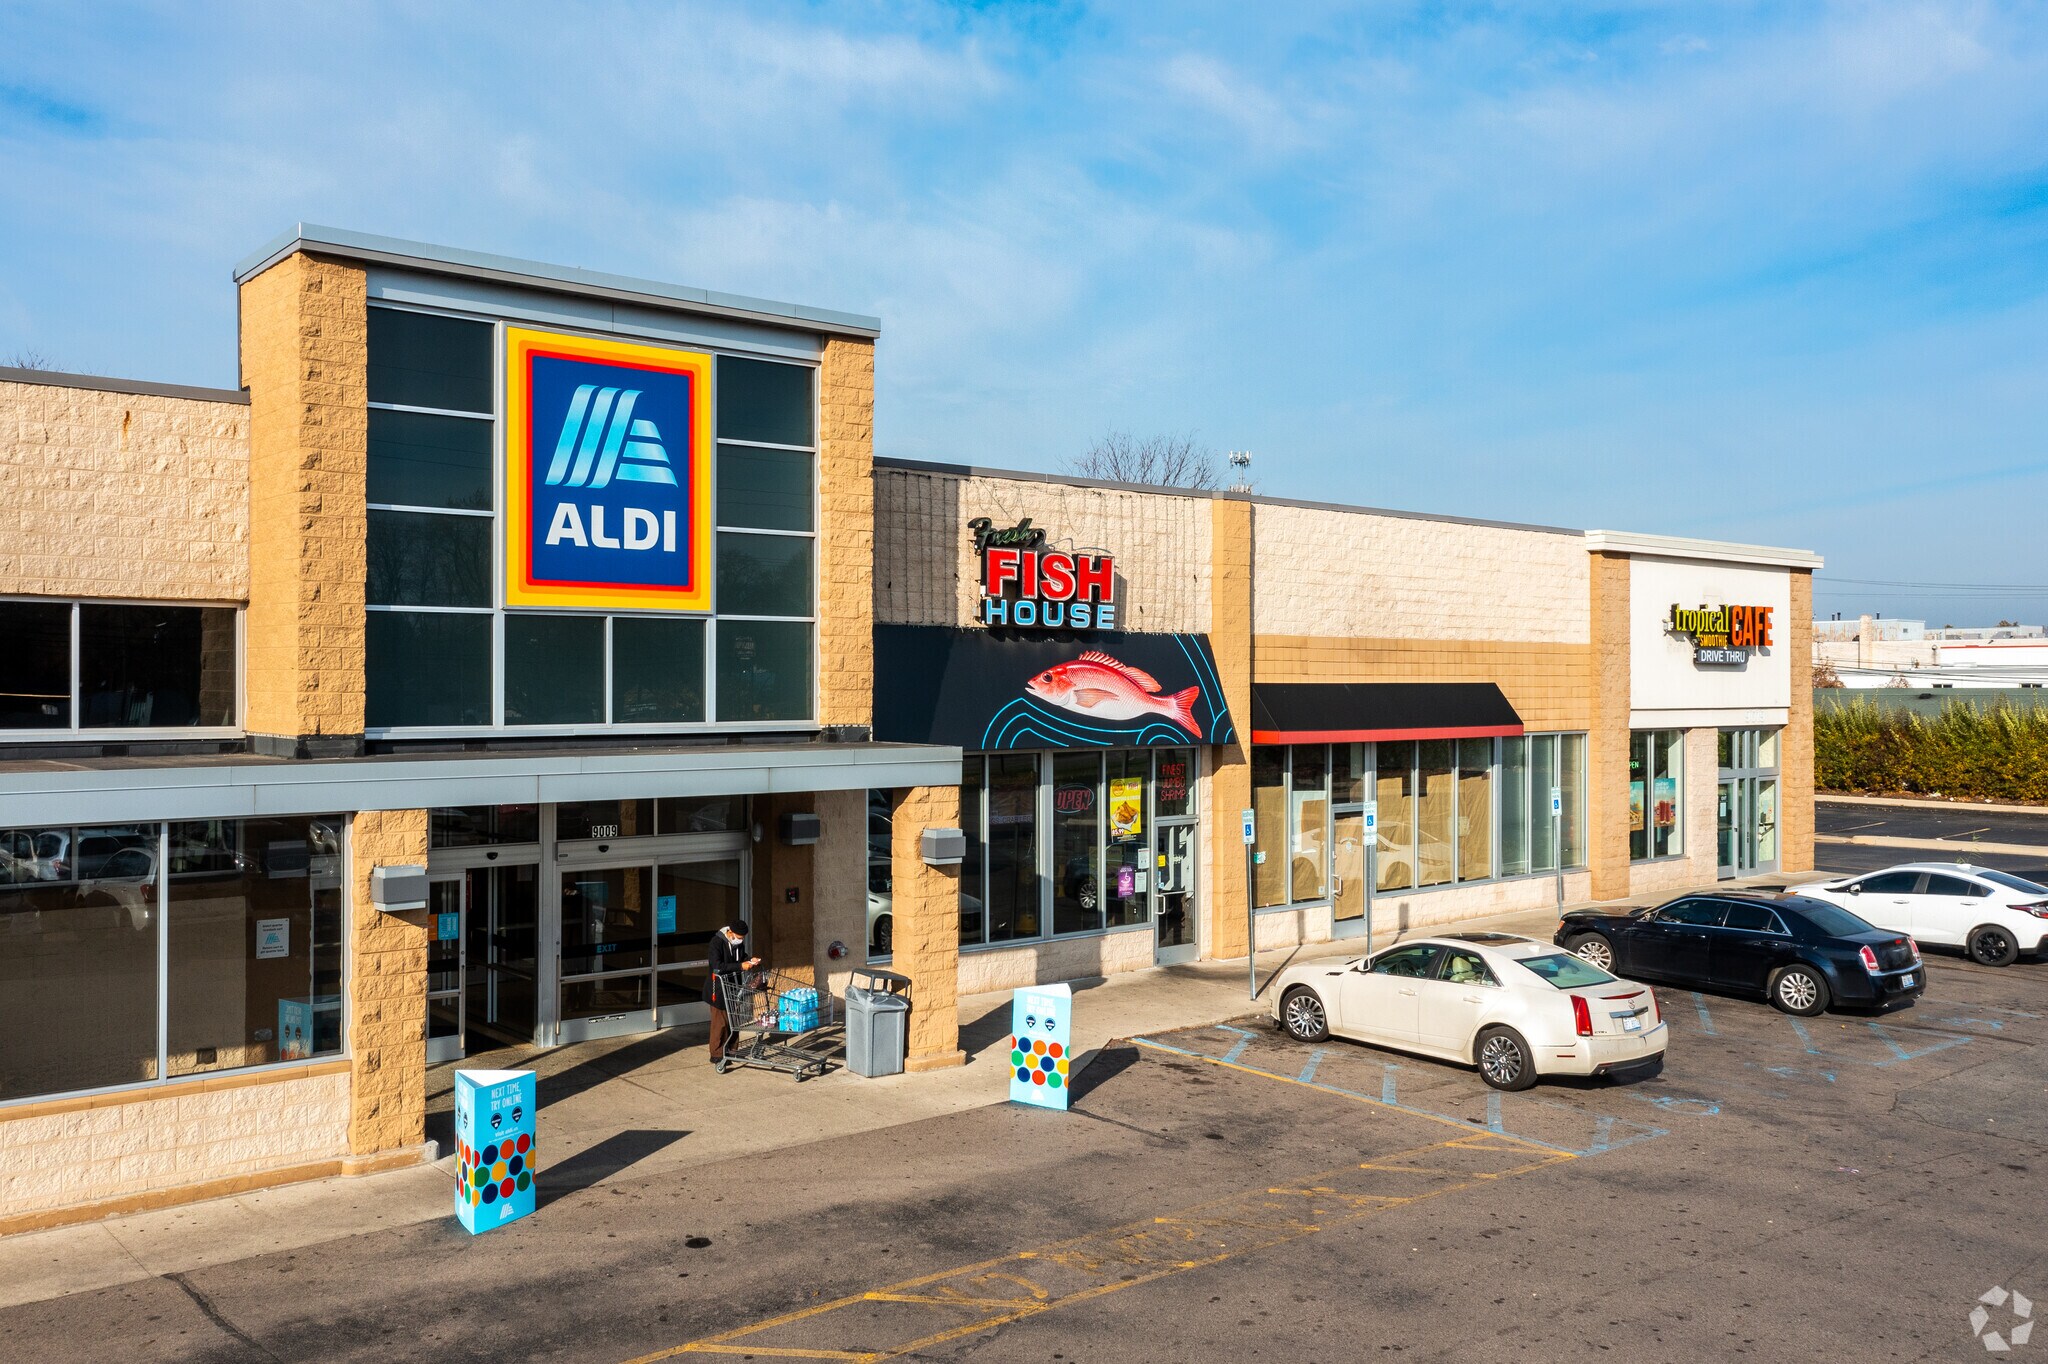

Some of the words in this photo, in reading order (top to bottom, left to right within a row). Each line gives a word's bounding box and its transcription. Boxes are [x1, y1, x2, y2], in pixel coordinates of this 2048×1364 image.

[545, 502, 676, 552] ALDI
[986, 547, 1115, 603] FISH
[986, 599, 1116, 630] HOUSE
[1675, 604, 1730, 638] tropical
[1732, 604, 1774, 646] CAFE
[1699, 634, 1728, 648] SMOOTHIE
[1701, 650, 1723, 662] DRIVE
[1725, 651, 1745, 663] THRU
[1162, 763, 1185, 776] FINEST
[1162, 776, 1186, 789] JUMBO
[1057, 789, 1091, 810] OPEN
[1160, 788, 1187, 801] SHRIMP
[592, 825, 618, 838] 9009
[596, 943, 617, 954] EXIT
[491, 1087, 505, 1099] NEXT
[507, 1081, 521, 1095] TIME,
[491, 1099, 501, 1111] TRY
[502, 1093, 522, 1107] ONLINE
